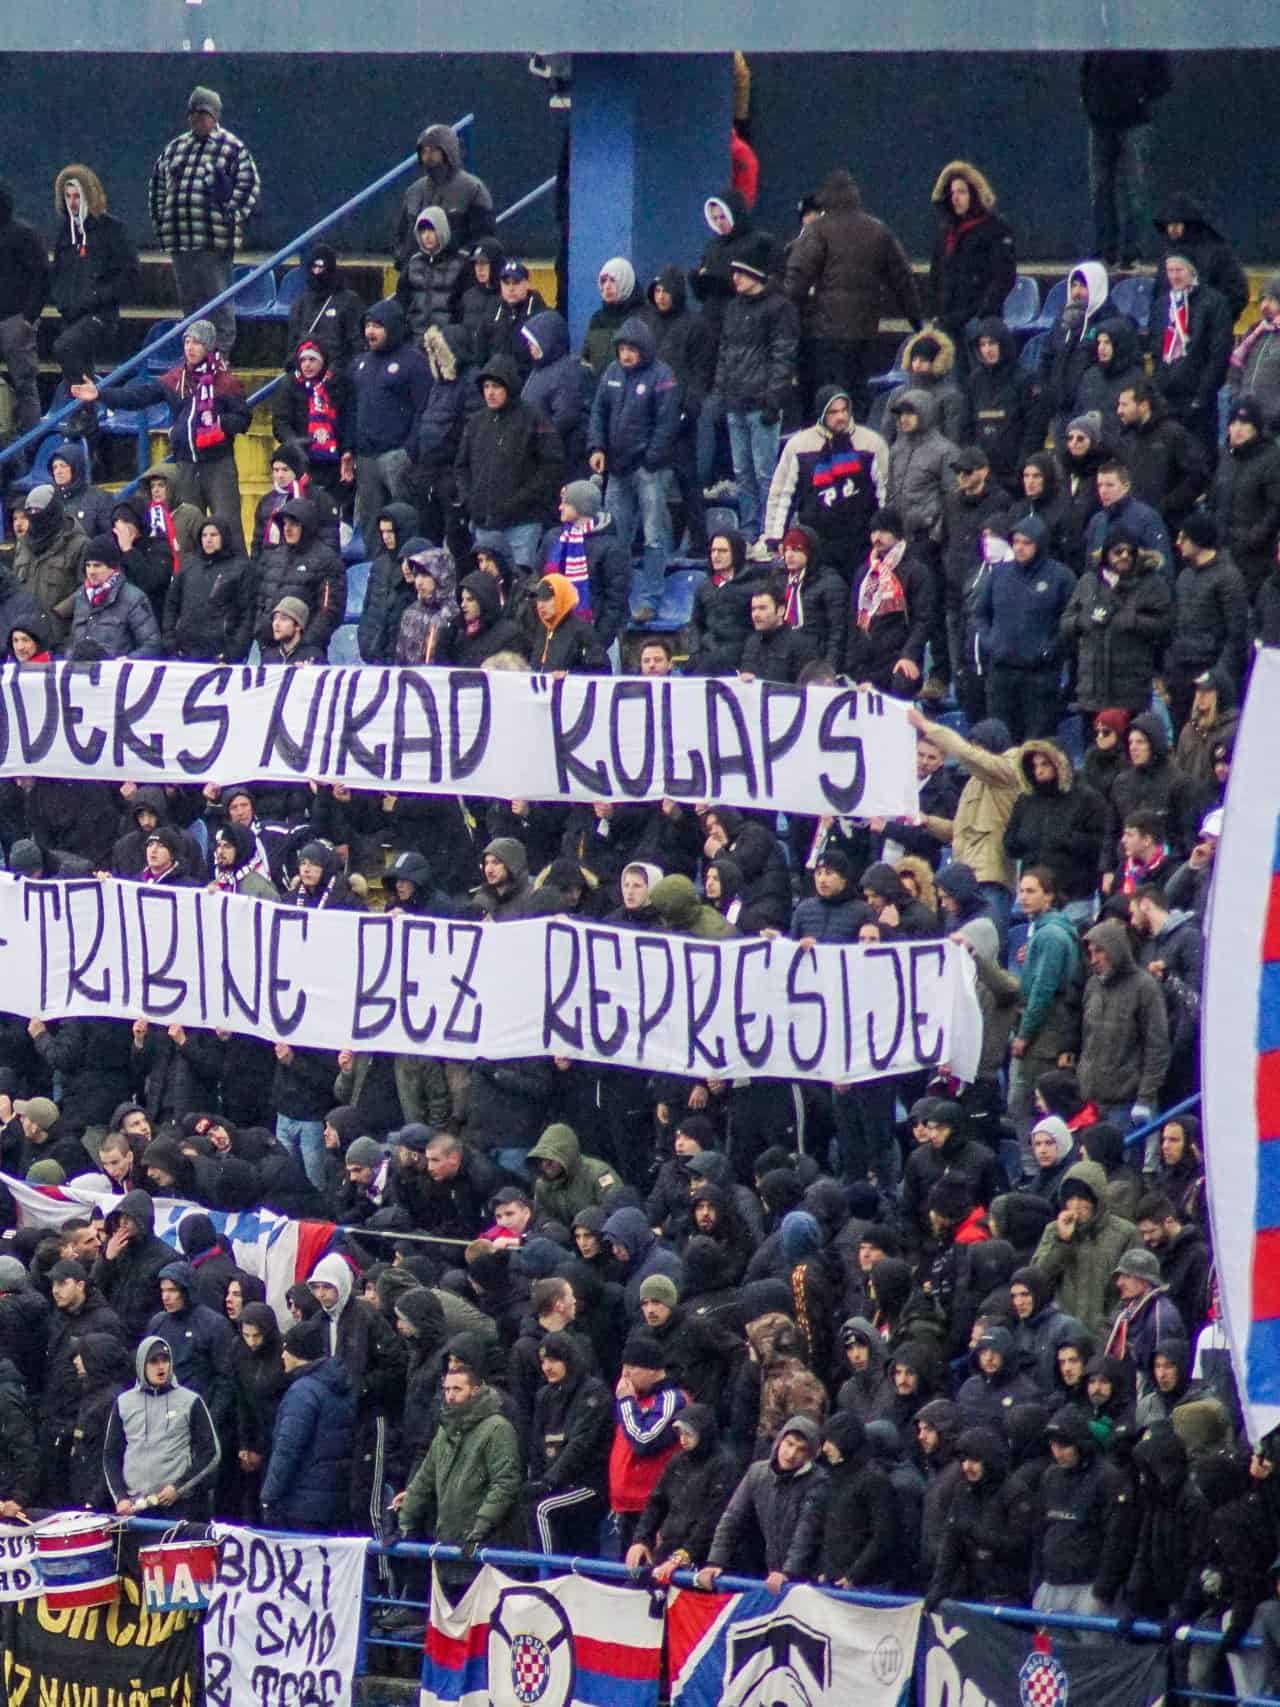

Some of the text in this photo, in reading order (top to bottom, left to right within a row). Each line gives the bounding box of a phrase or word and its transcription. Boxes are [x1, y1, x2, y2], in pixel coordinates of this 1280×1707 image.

[258, 664, 491, 784] NIKAD
[530, 672, 885, 814] "KOLAPS"
[24, 881, 308, 1037] TRIBINE
[351, 916, 483, 1043] BEZ
[542, 920, 946, 1073] REPRESIJE
